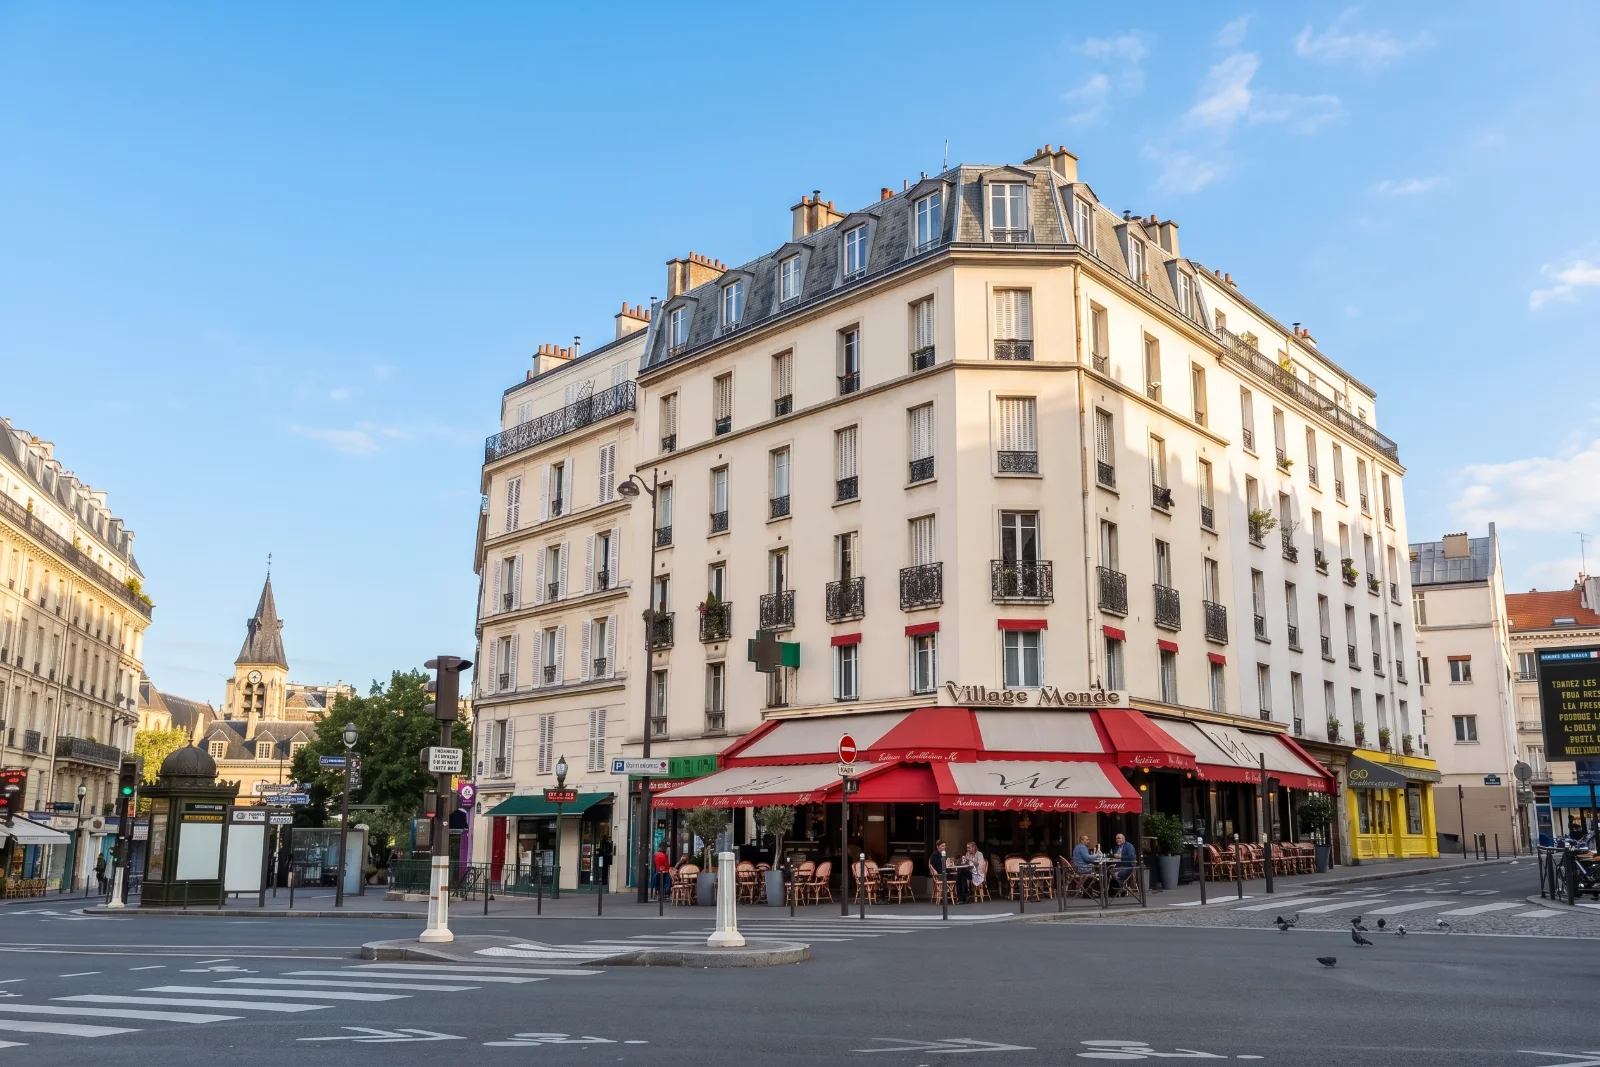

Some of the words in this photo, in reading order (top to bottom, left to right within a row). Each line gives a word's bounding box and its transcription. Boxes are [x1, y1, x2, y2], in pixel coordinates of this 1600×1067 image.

[1583, 679, 1597, 687] LES
[945, 681, 1029, 706] Village
[1037, 686, 1121, 706] Monde
[615, 762, 623, 770] P
